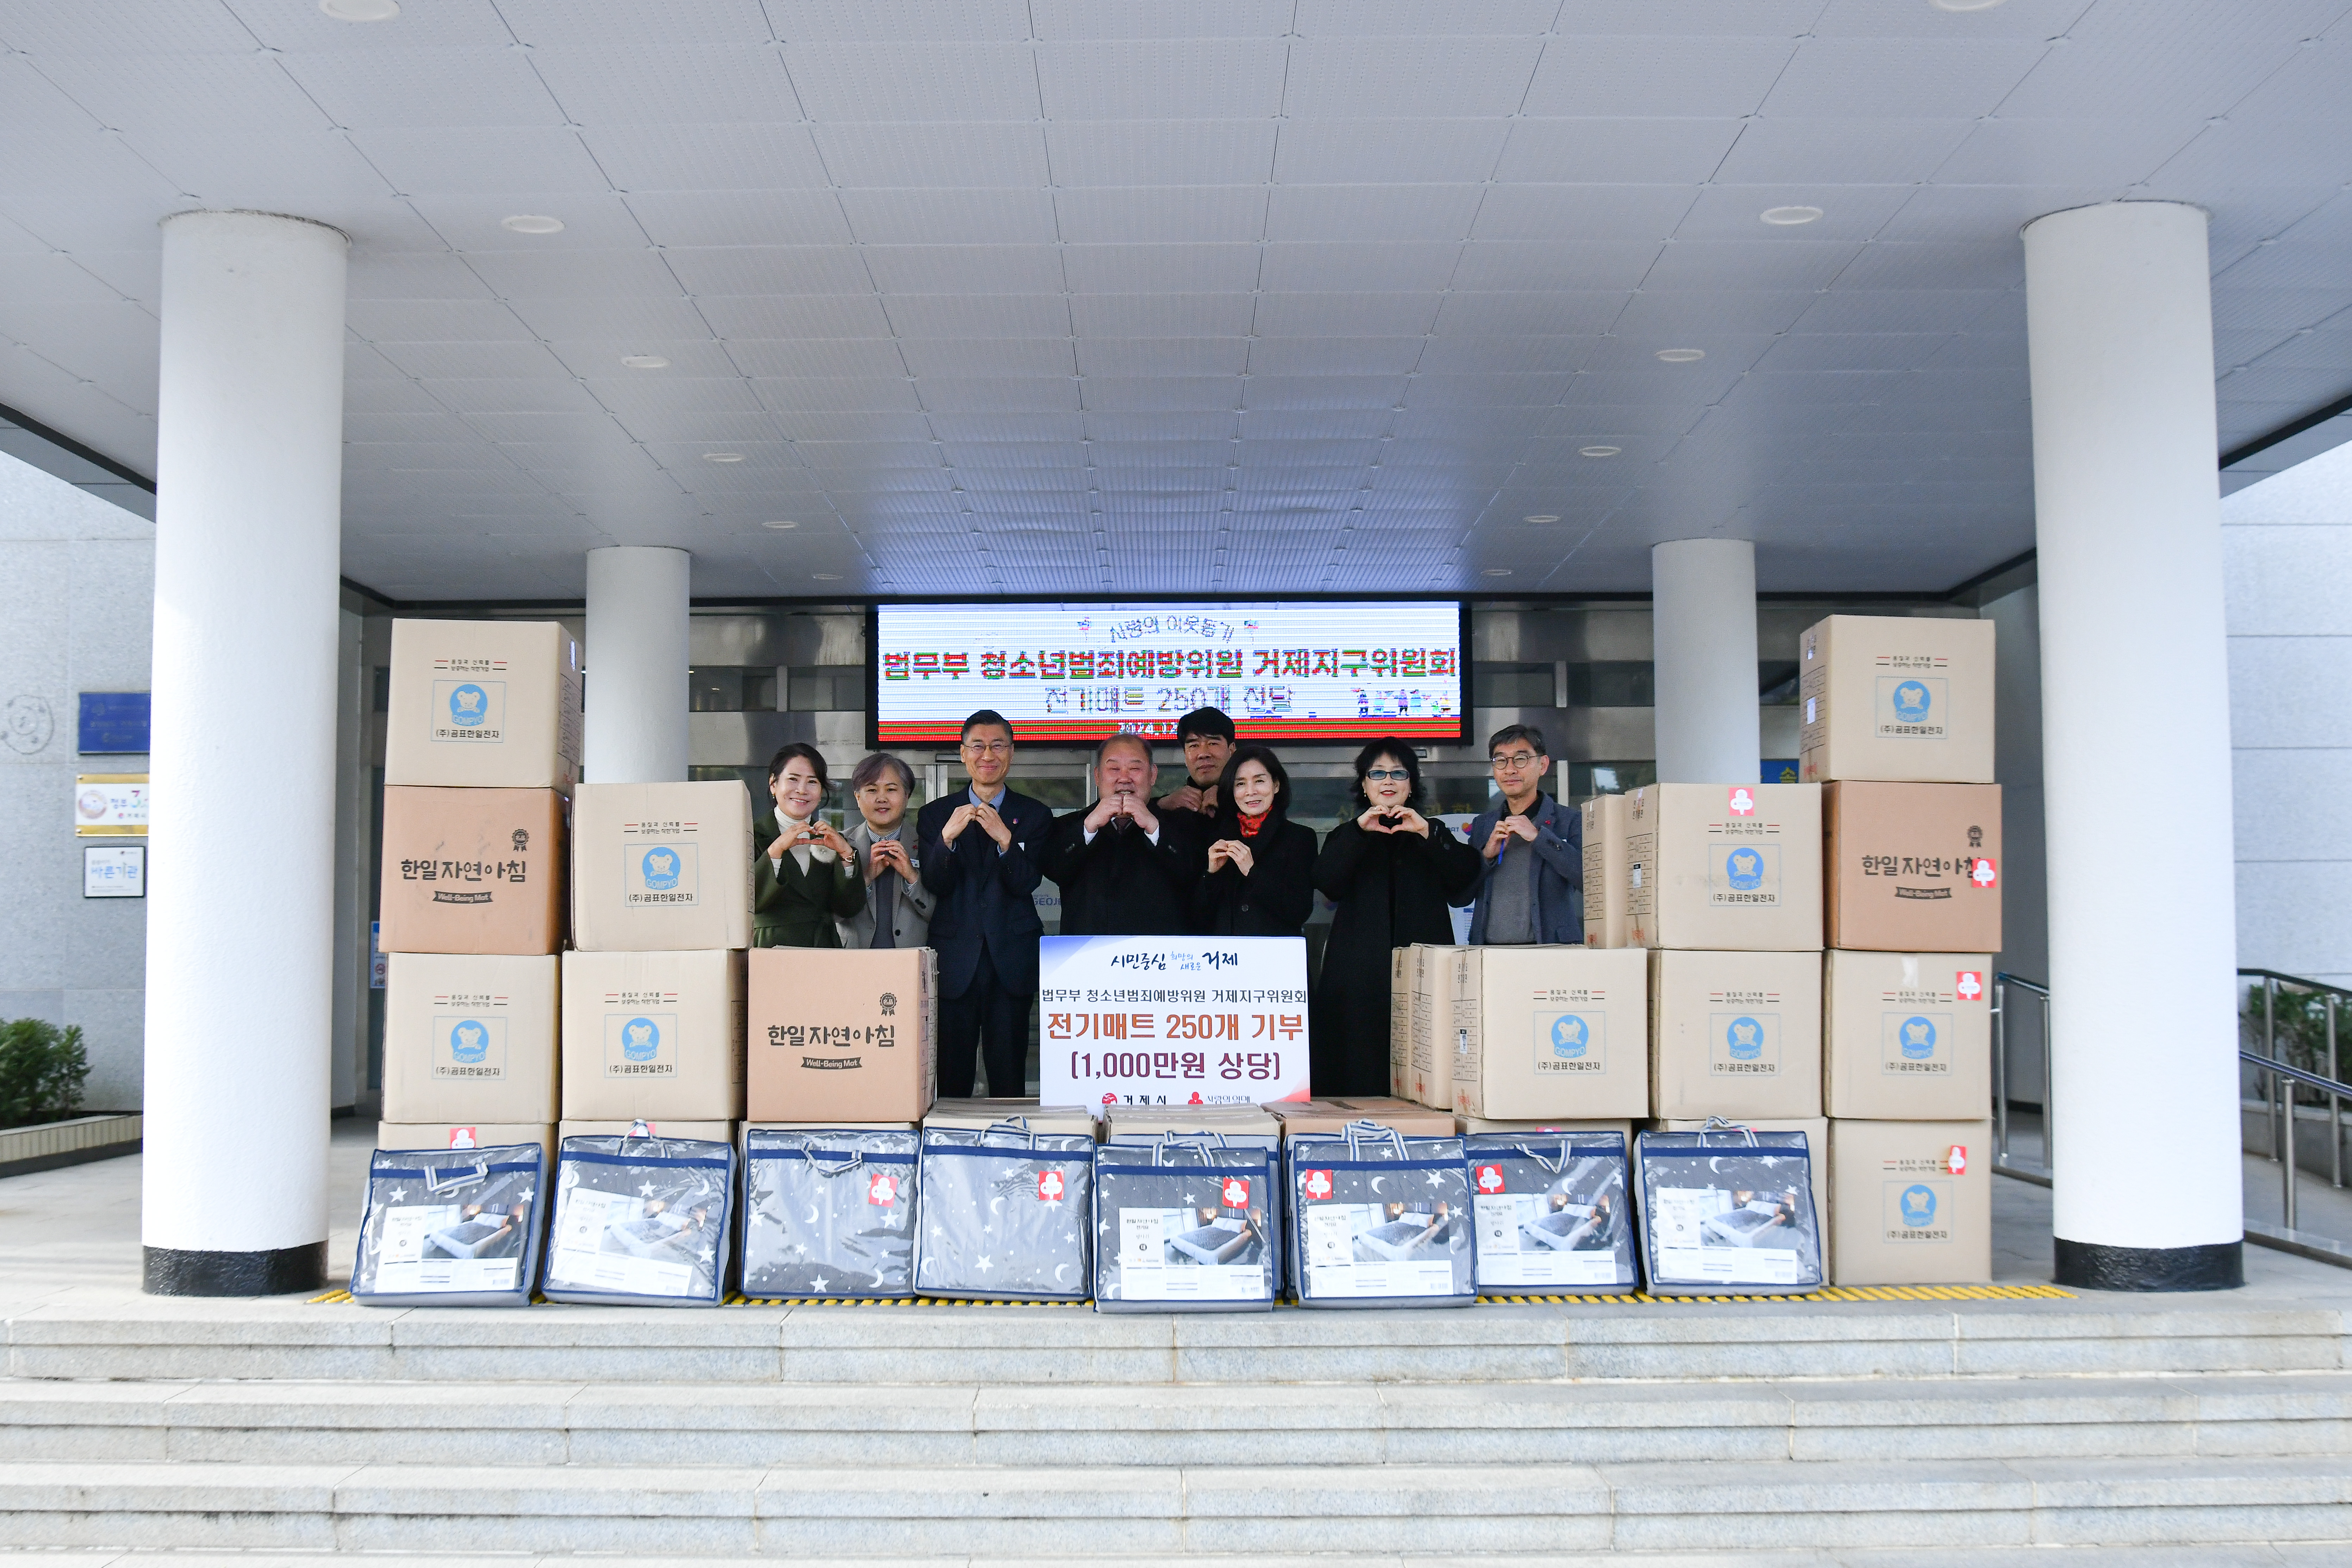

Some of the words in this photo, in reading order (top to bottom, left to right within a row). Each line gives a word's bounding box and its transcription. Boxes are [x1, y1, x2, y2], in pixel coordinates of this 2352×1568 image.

[883, 652, 969, 680] 법무부
[980, 650, 1242, 680] 청소년범죄예방위원
[1252, 648, 1455, 678] 거제지구위원회
[1045, 685, 1147, 714] 전기매트
[436, 729, 499, 739] (주)곰표한일전자
[629, 894, 693, 902] (주)곰표한일전자
[1713, 894, 1775, 902] (주)곰표한일전자
[1111, 953, 1166, 970] 시민중심
[1170, 951, 1193, 961] 희망의
[1202, 951, 1238, 970] 거제
[1181, 962, 1201, 971] 새로운
[1042, 989, 1081, 1002] 법무부
[1087, 989, 1205, 1002] 청소년범죄예방위원
[1212, 990, 1306, 1003] 거제지구위원회
[1047, 1013, 1155, 1040] 전기매트
[1166, 1014, 1239, 1040] 250개
[1251, 1014, 1303, 1040] 기부
[806, 1058, 842, 1069] Well-Being
[1538, 1062, 1600, 1070] (주)곰표한일전자
[609, 1065, 673, 1074] (주)곰표한일전자
